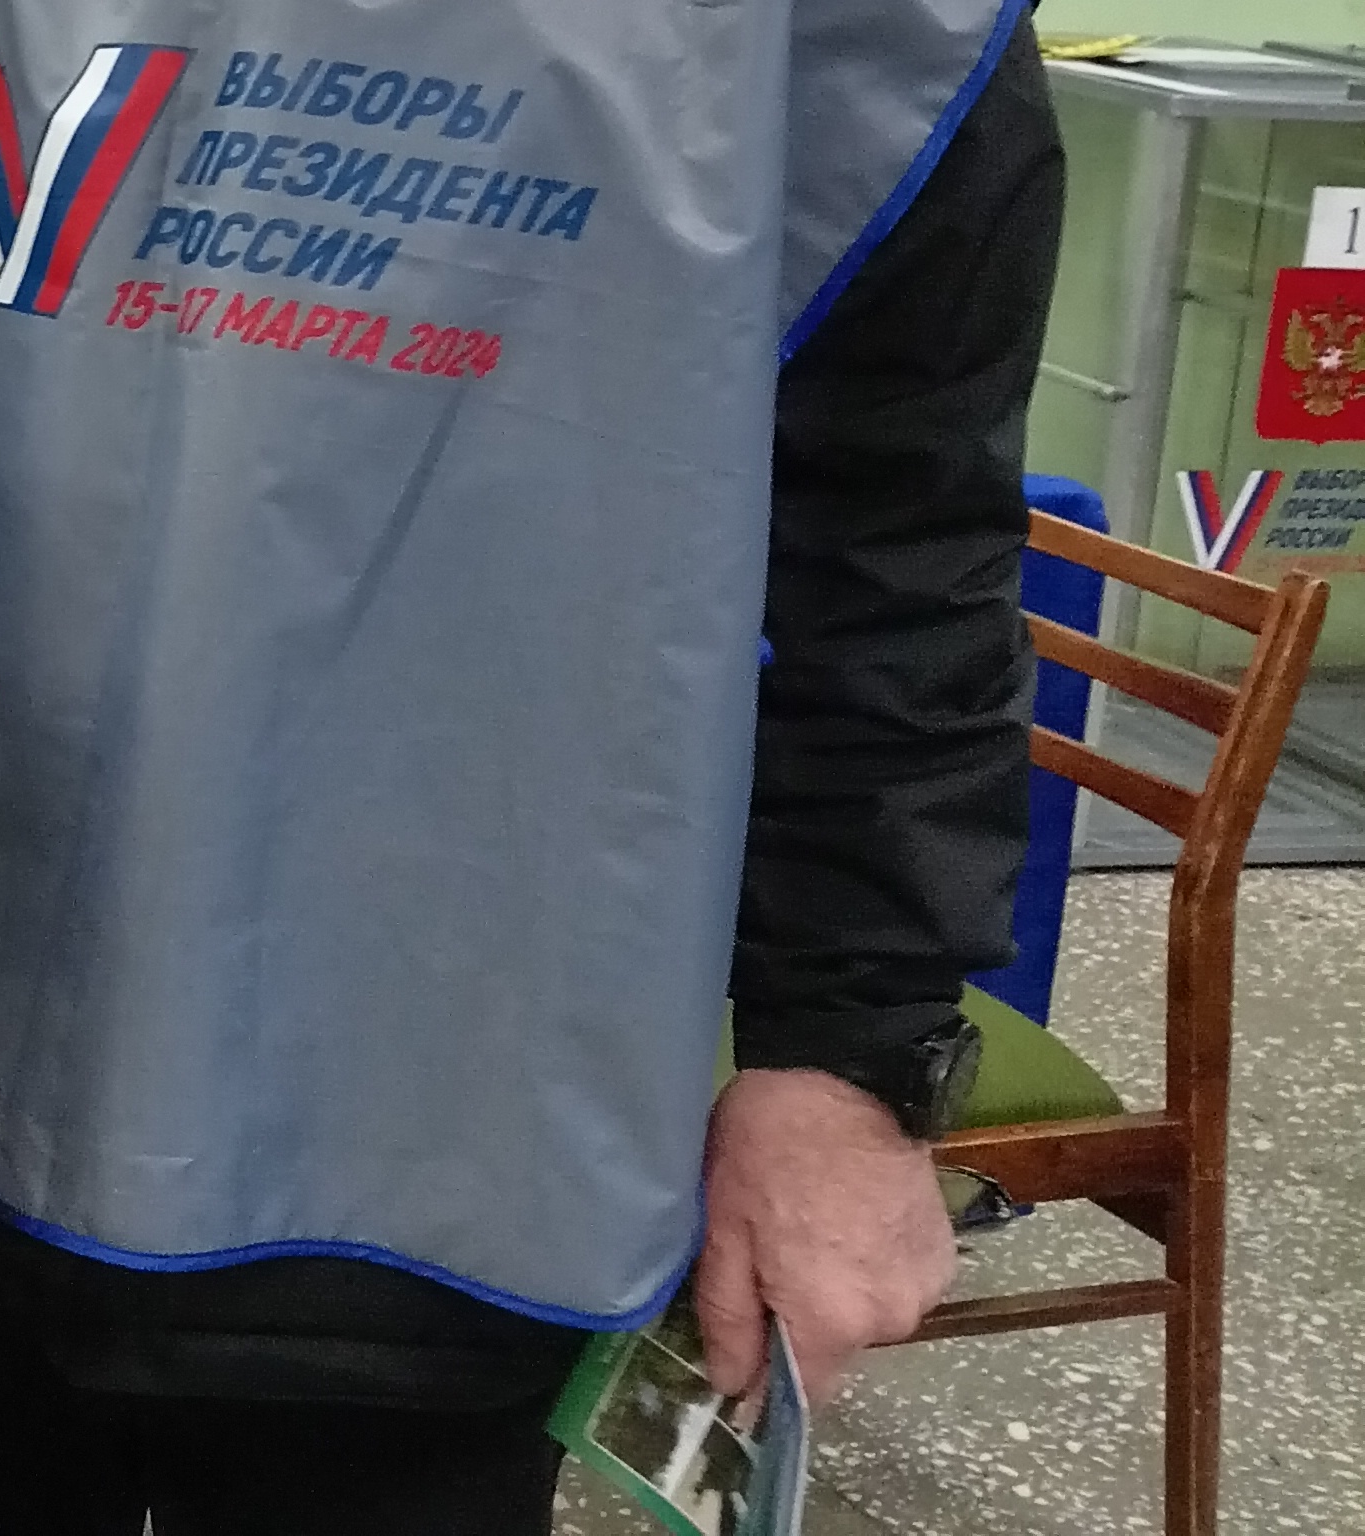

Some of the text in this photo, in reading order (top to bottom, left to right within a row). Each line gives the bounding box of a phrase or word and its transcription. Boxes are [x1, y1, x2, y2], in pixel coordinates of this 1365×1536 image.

[215, 48, 524, 144] ВЫБОРЫ
[176, 129, 599, 241] ПРЕЗИДЕНТА
[133, 206, 402, 291] РОССИИ
[213, 291, 390, 365] МАРТА
[389, 322, 503, 379] 2024
